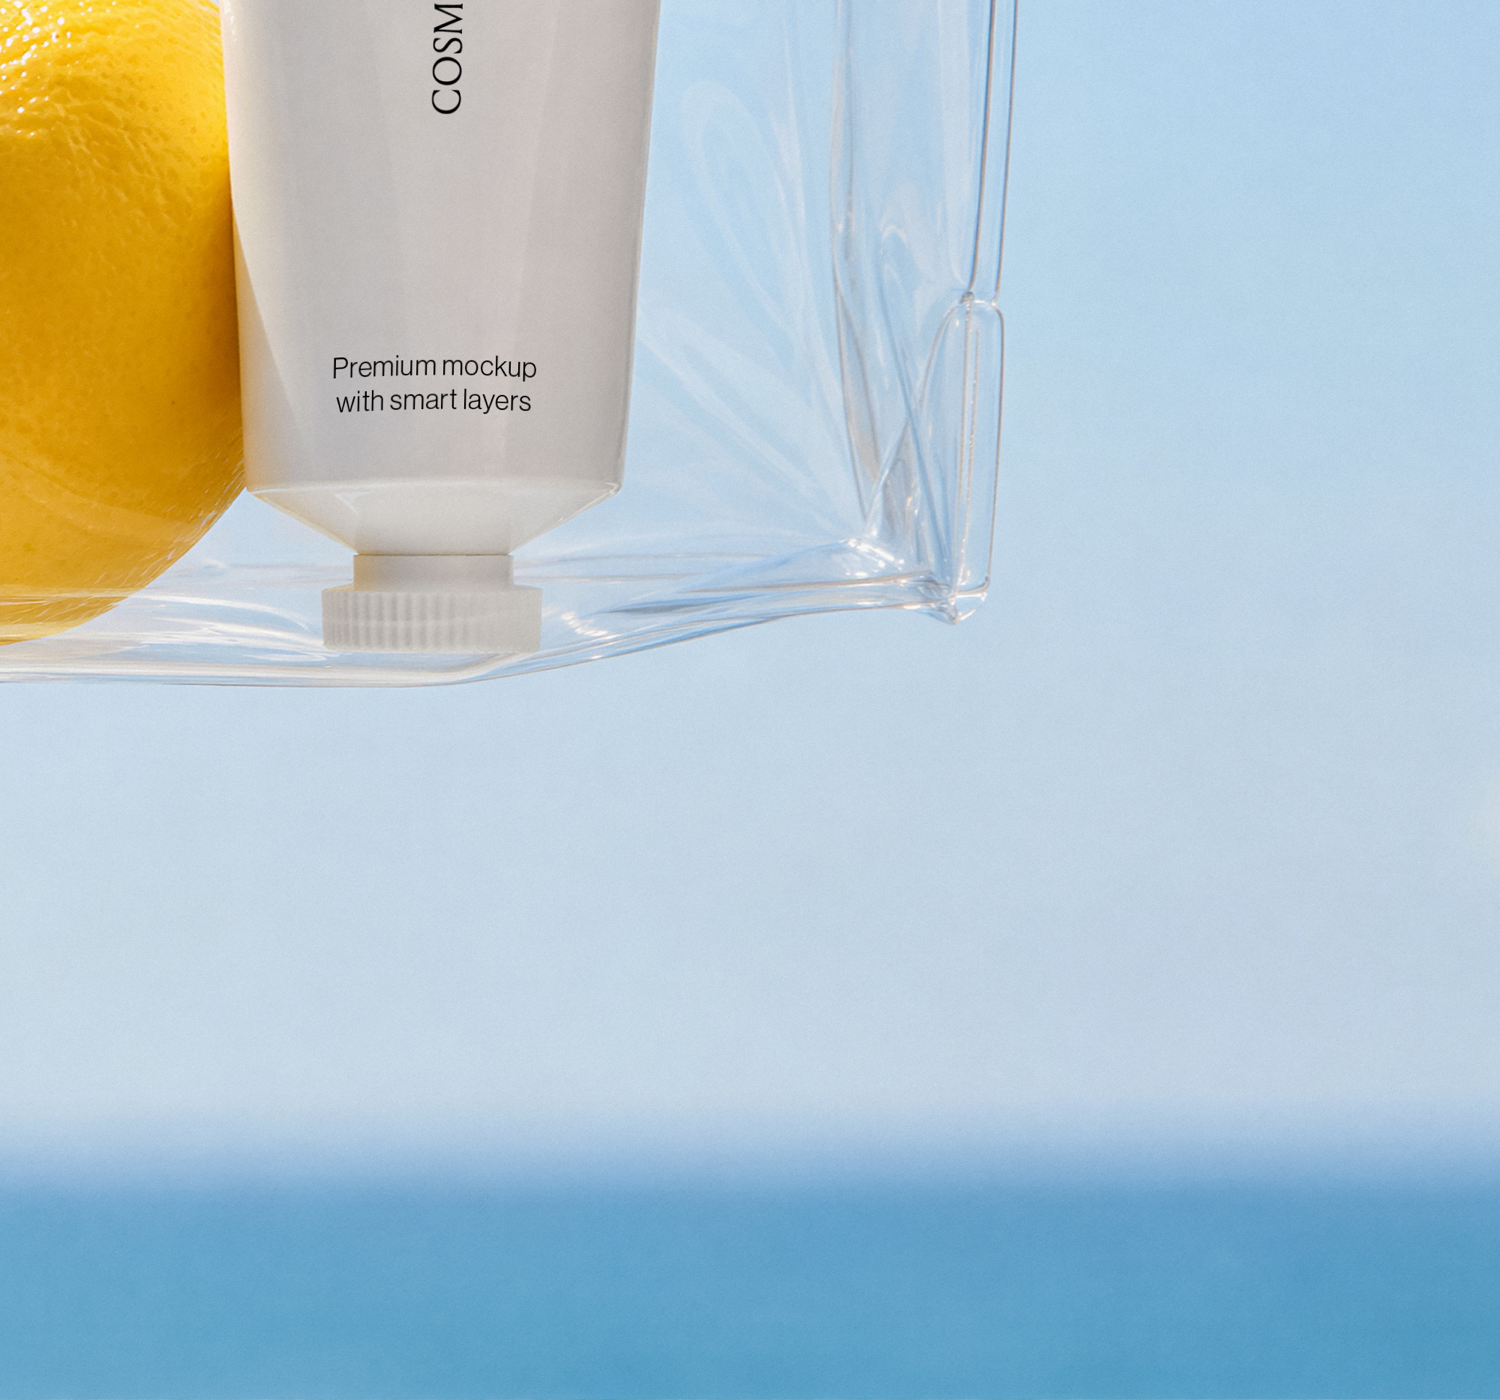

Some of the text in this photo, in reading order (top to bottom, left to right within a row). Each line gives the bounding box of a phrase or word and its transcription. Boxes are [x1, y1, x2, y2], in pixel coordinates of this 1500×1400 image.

[332, 355, 537, 382] Premium mockup
[336, 387, 532, 414] with smart layers
